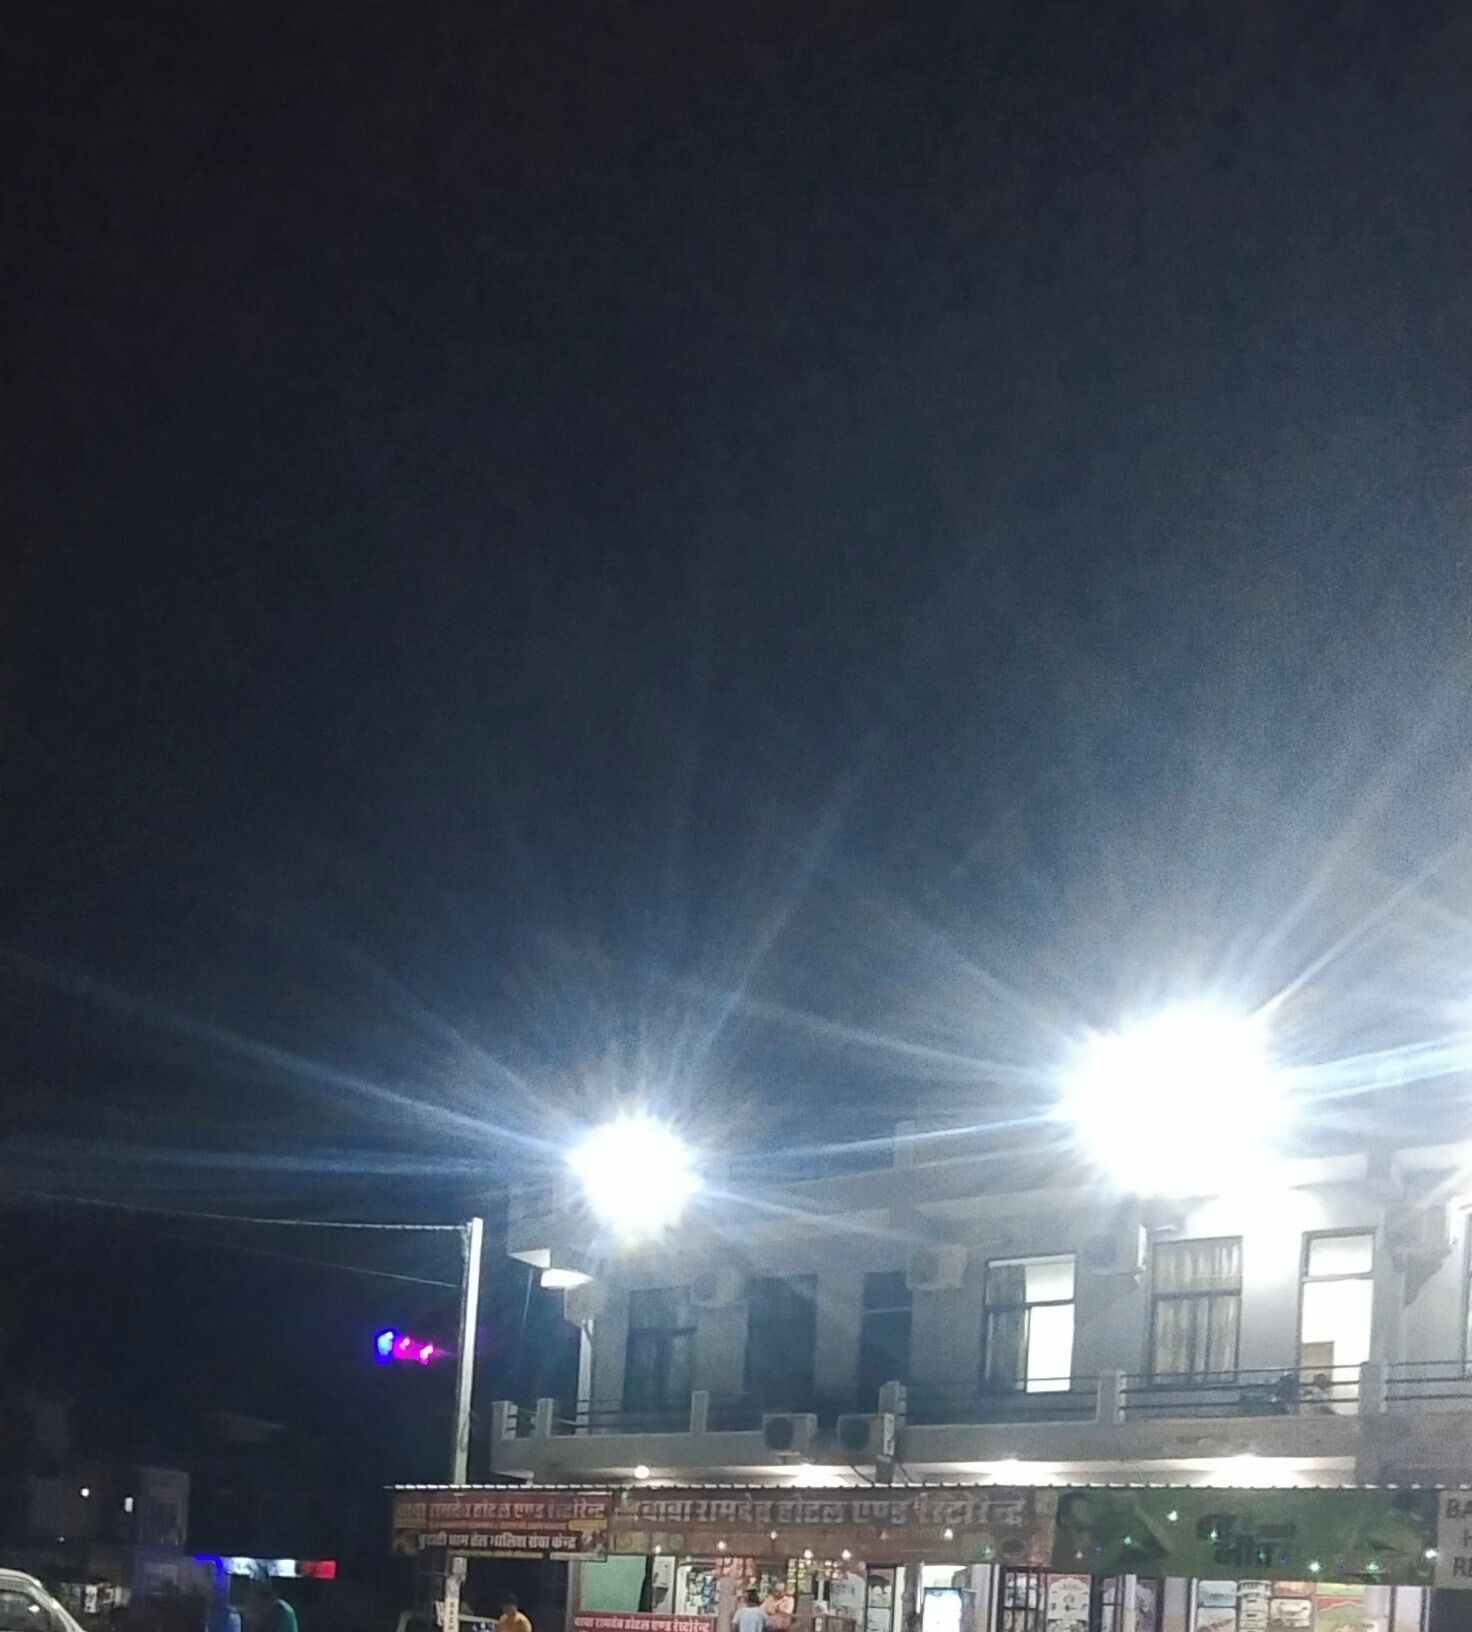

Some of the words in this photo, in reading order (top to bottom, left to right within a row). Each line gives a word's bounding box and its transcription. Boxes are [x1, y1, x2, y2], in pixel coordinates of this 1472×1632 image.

[473, 1498, 511, 1519] होटल
[641, 1499, 694, 1523] बाबा
[696, 1493, 774, 1524] रामदेव
[777, 1493, 848, 1524] होटल
[851, 1499, 909, 1525] एण्ड
[595, 1616, 623, 1629] रामदेव
[624, 1616, 650, 1631] होटल
